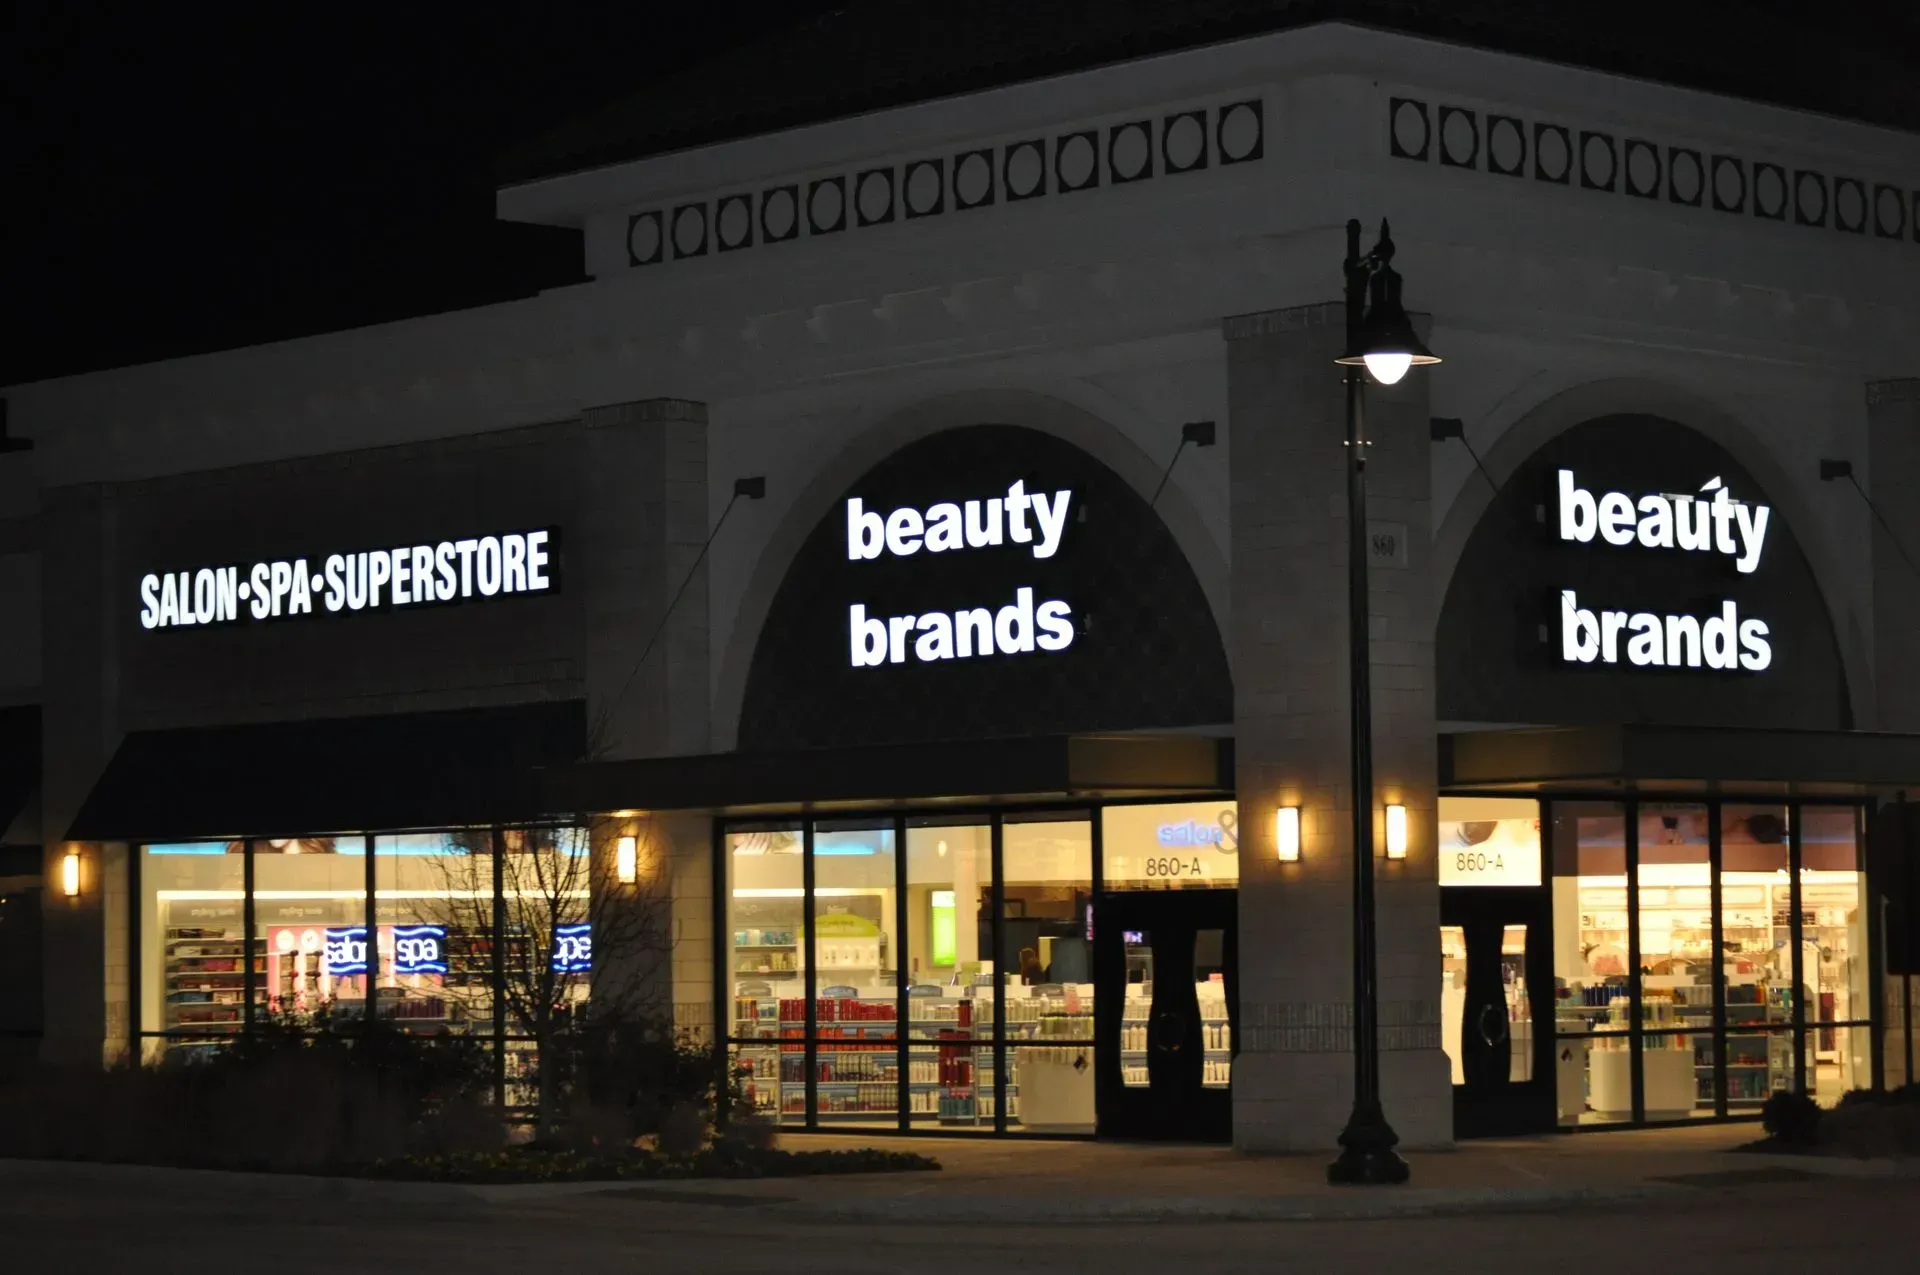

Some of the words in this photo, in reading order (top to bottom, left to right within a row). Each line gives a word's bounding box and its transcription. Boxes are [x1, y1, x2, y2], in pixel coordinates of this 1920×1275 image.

[847, 479, 1072, 559] beauty
[1372, 534, 1396, 557] 860
[1558, 469, 1770, 574] beauty
[849, 586, 1075, 667] brands
[1561, 589, 1772, 671] brands
[1146, 857, 1202, 877] 860-A
[1456, 852, 1504, 872] 860-A
[397, 938, 438, 967] spa
